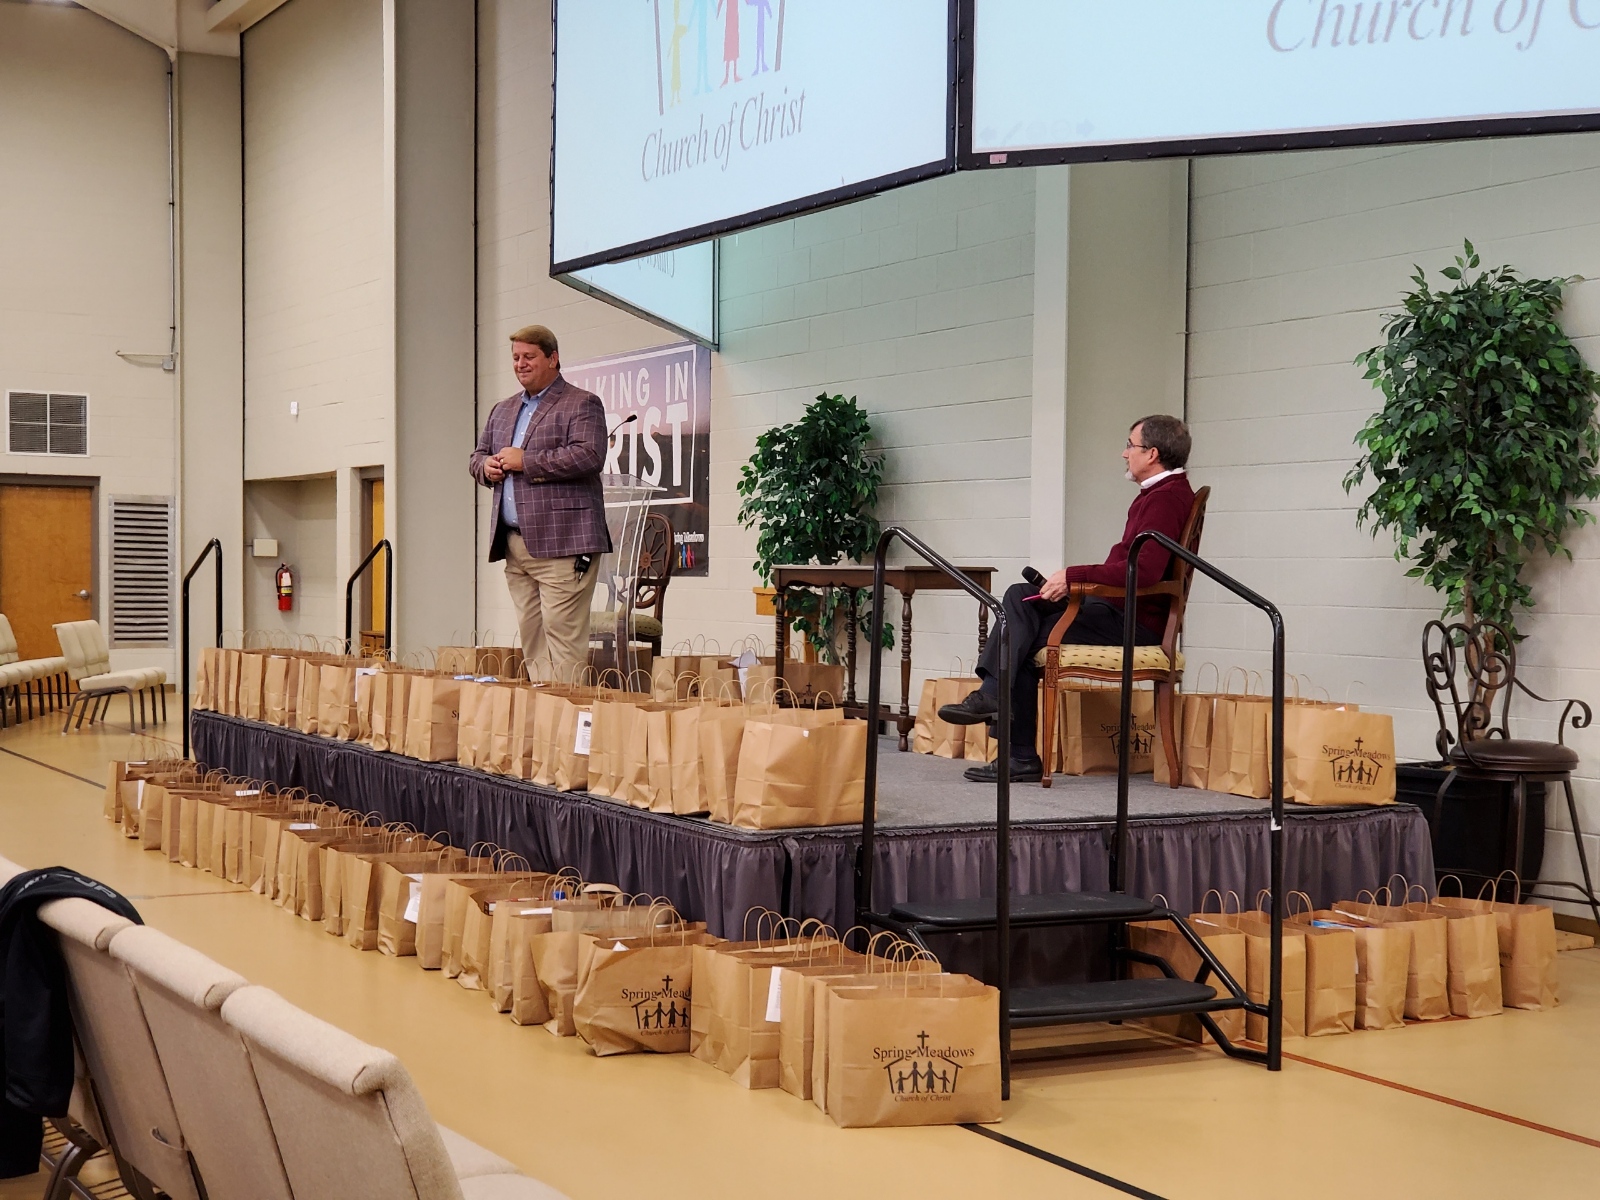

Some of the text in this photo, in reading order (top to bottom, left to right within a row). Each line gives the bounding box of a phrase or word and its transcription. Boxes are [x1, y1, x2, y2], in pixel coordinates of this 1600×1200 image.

[1266, 0, 1474, 53] Church
[641, 85, 807, 182] Church of Christ
[665, 361, 689, 403] IN
[1322, 744, 1391, 761] Spring Meadows
[621, 986, 691, 1002] Spring Mead
[872, 1045, 975, 1063] Spring Meadows
[894, 1094, 952, 1104] Church of Christ
